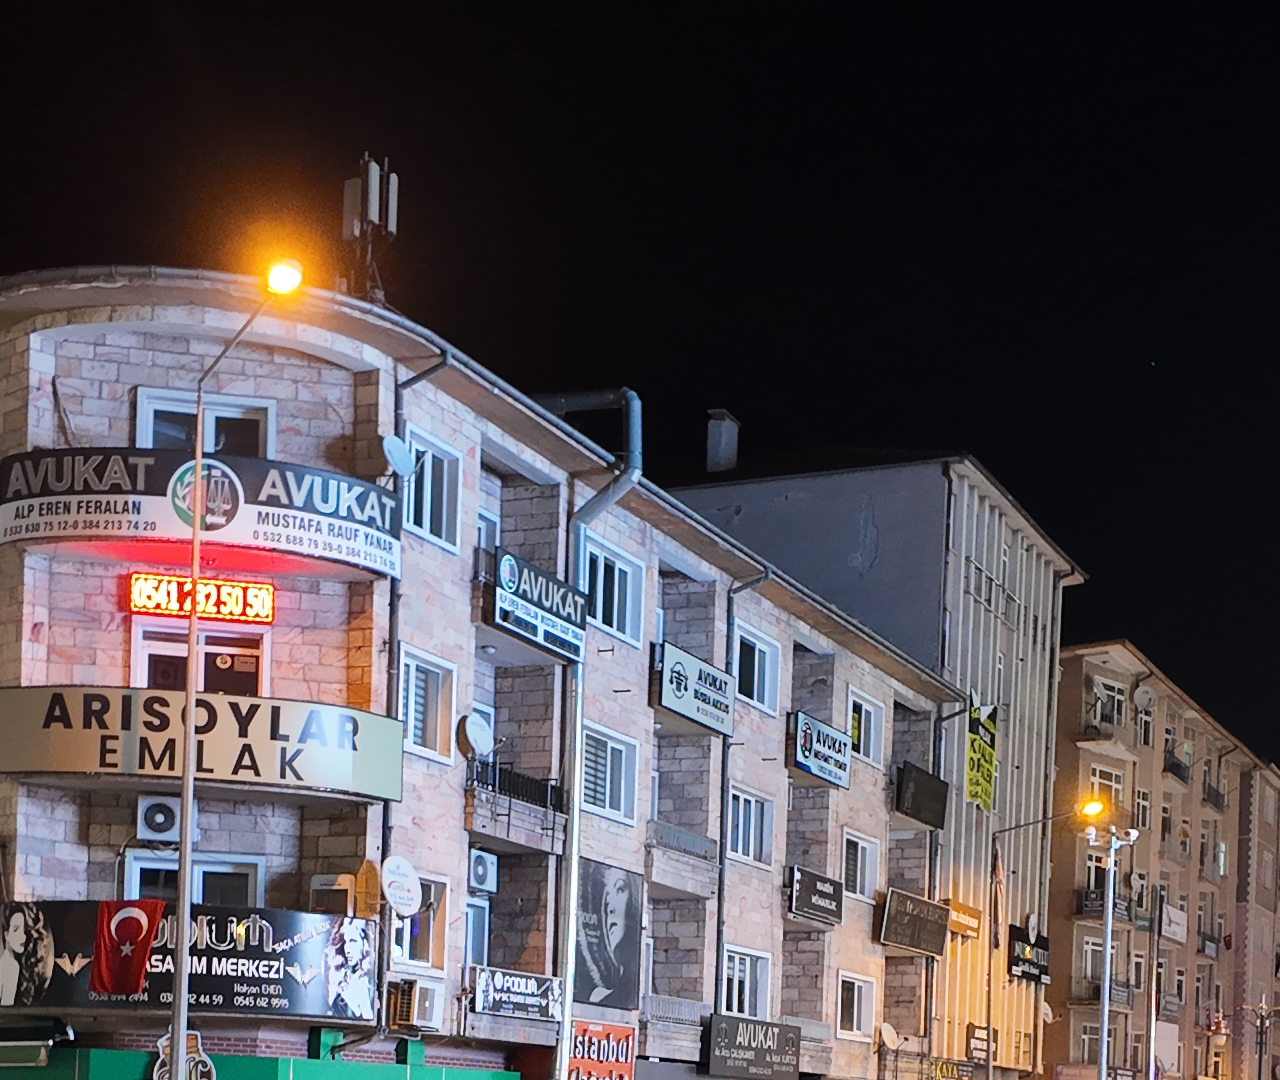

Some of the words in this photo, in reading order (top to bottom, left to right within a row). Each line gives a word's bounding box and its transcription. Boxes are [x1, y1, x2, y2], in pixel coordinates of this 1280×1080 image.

[6, 455, 155, 498] AVUKAT
[14, 504, 35, 520] ALP
[39, 501, 71, 516] EREN
[77, 500, 141, 515] FERALAN
[257, 469, 396, 530] AVUKAT
[44, 521, 53, 531] 75
[82, 520, 100, 530] 384
[103, 520, 122, 530] 213
[127, 520, 139, 531] 74
[143, 521, 157, 532] 20
[257, 511, 323, 535] MUSTAFA
[327, 522, 360, 542] RAUF
[263, 531, 282, 543] 532
[133, 579, 180, 611] 0541
[220, 585, 243, 615] 50
[245, 588, 269, 617] 50
[519, 568, 585, 623] AVUKAT
[698, 668, 728, 694] AVUKAT
[42, 693, 360, 751] ARISOYLAR
[99, 734, 305, 782] EMLAK
[816, 730, 847, 757] AVUKAT
[212, 957, 285, 978] MERKEZİ
[736, 1022, 779, 1050] AVUKAT
